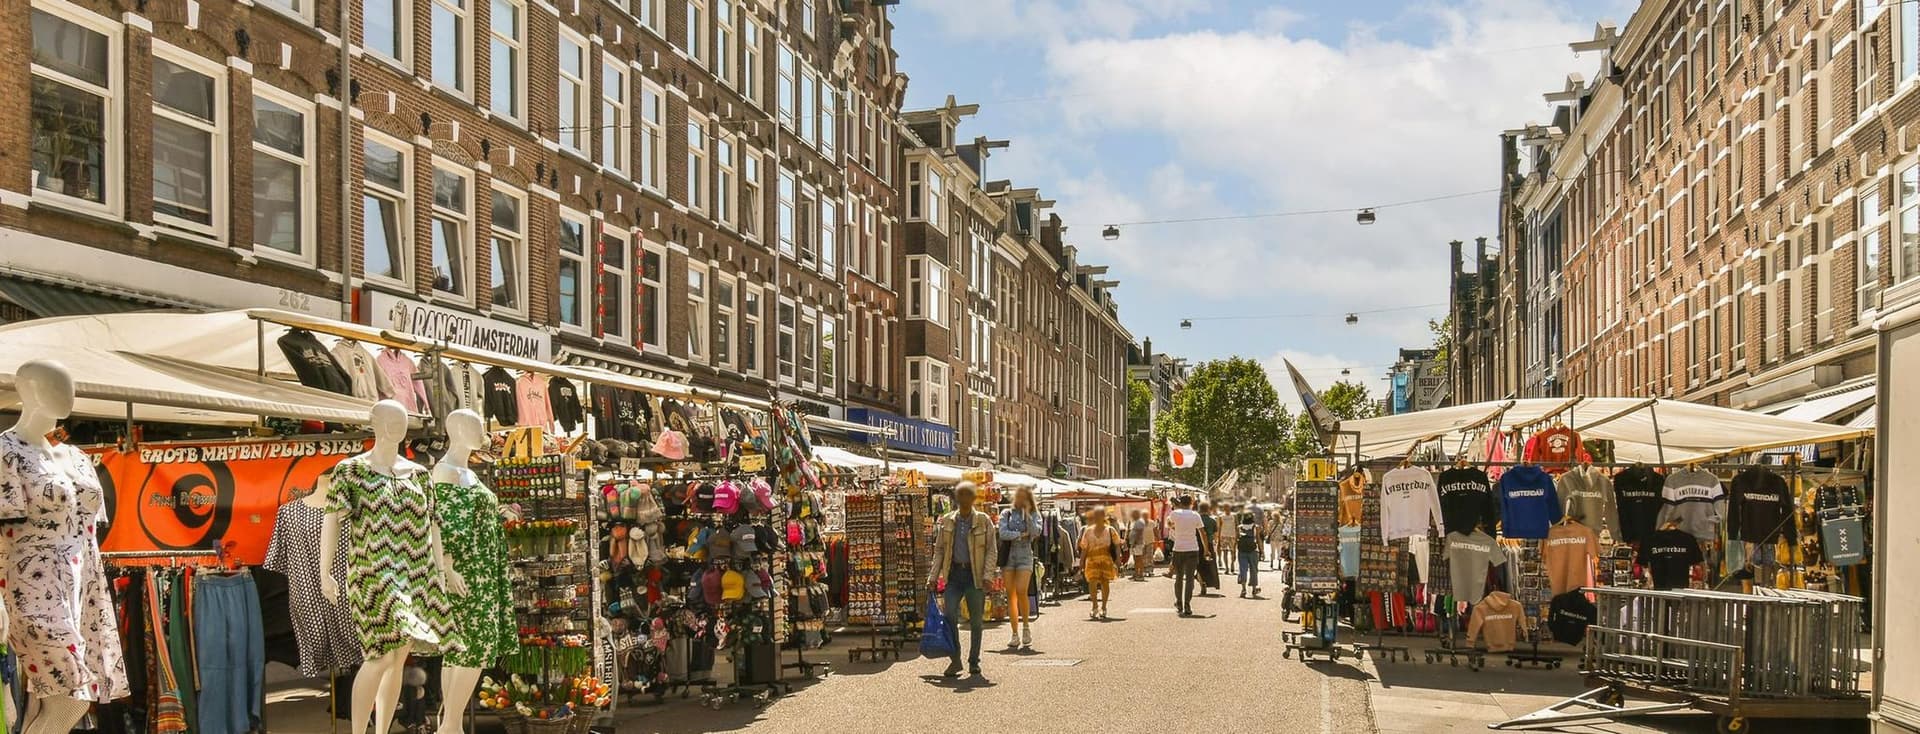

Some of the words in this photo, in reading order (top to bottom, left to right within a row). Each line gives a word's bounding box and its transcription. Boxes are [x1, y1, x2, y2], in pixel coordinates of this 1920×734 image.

[278, 290, 311, 311] 262
[413, 307, 472, 347] RANCHI
[472, 326, 539, 360] AMSTERDAM
[920, 427, 950, 449] STOFFEN
[140, 447, 198, 464] GROTE
[201, 440, 316, 462] MATEN/PLUS
[320, 440, 364, 456] SIZE
[1312, 463, 1319, 478] 1
